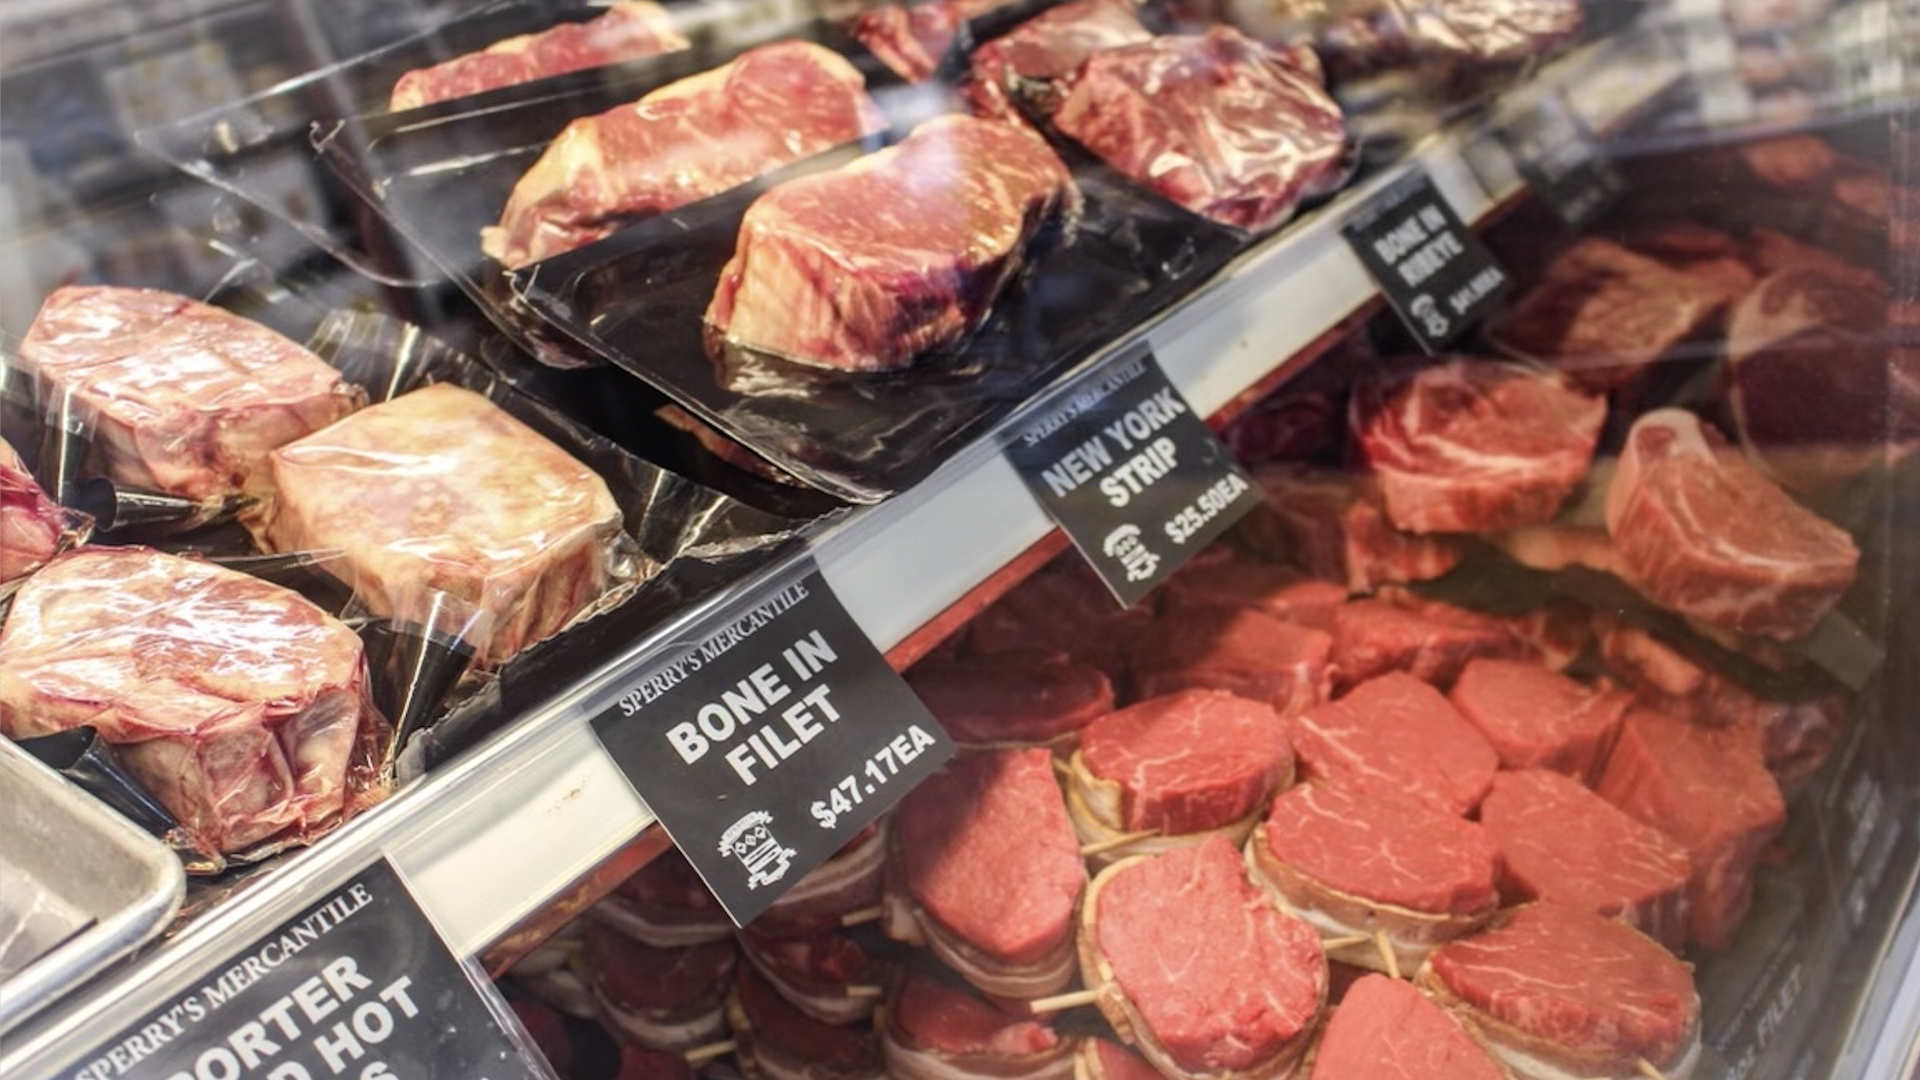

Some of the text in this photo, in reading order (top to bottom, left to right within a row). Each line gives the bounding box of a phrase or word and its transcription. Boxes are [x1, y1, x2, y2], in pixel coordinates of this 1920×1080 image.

[1374, 203, 1448, 266] BONE IN
[1041, 386, 1186, 498] NEW YORK
[1099, 436, 1177, 507] STRIP
[1164, 472, 1249, 544] $25.50EA
[619, 581, 809, 717] SPERRY'S MERCANTILE
[665, 629, 839, 766] BONE IN
[724, 683, 842, 786] FILET
[810, 723, 936, 830] $47.17EA
[201, 882, 373, 1010] MERCANTILE
[164, 955, 373, 1080] ORTER
[313, 975, 419, 1075] HOT
